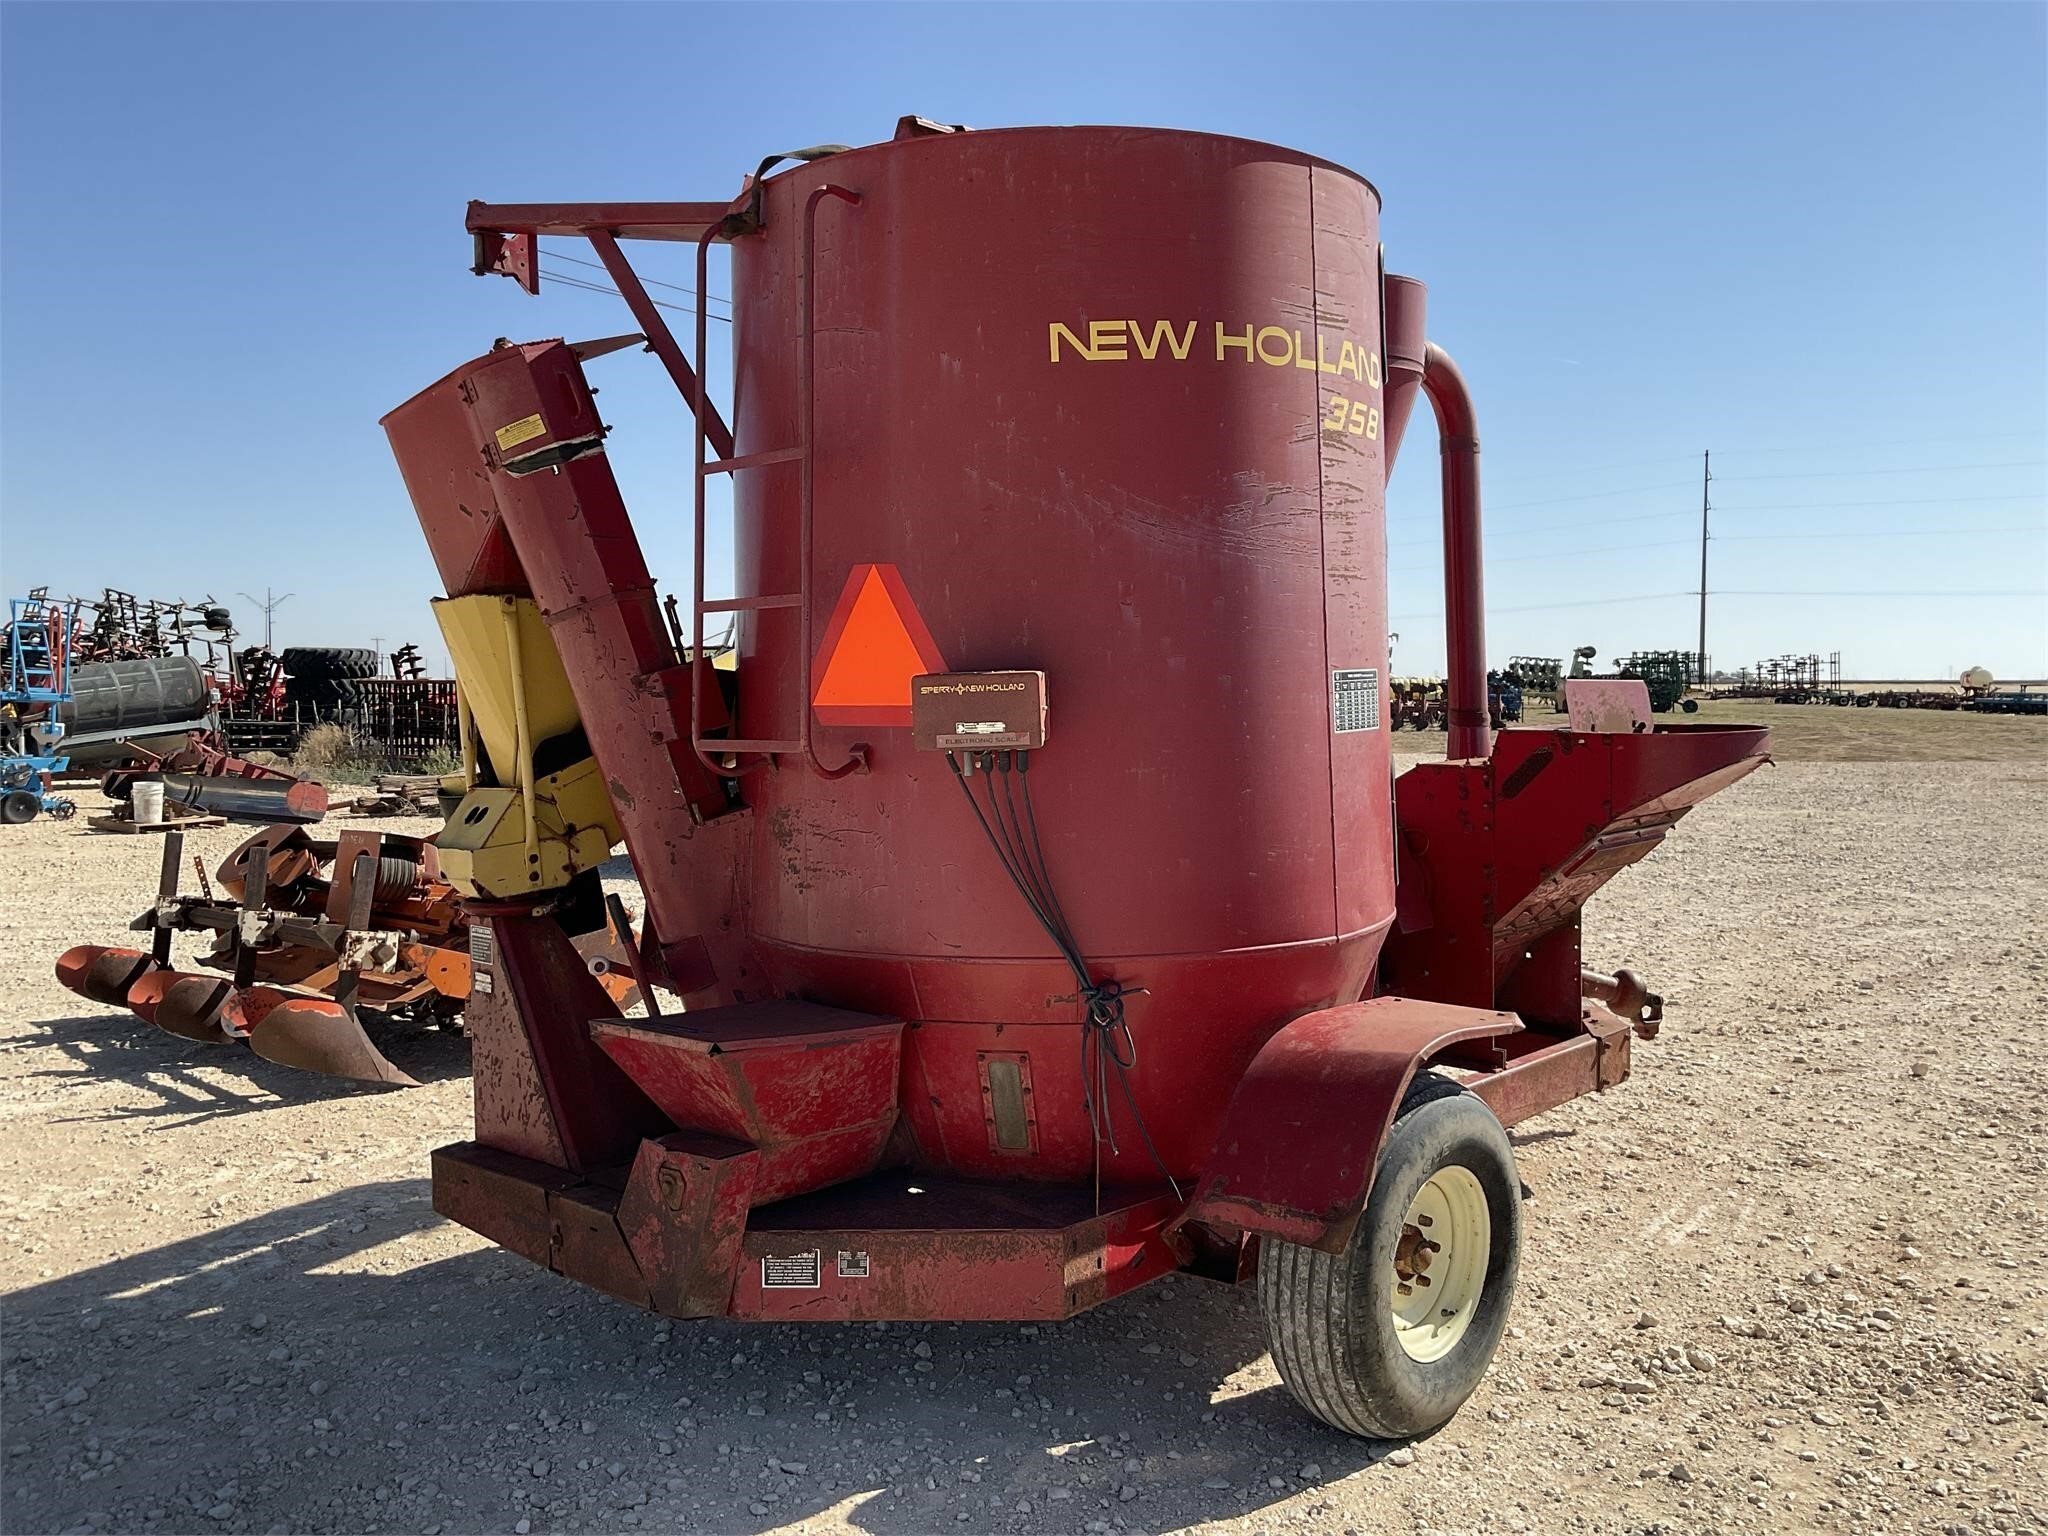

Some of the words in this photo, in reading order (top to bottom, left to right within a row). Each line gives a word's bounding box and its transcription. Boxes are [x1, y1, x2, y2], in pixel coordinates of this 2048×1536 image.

[1049, 319, 1198, 363] NEW
[1214, 321, 1381, 390] HOLLAND
[1323, 395, 1380, 441] 358
[920, 685, 955, 695] SPERRY
[965, 684, 984, 692] NEW
[986, 682, 1025, 691] HOLLAND
